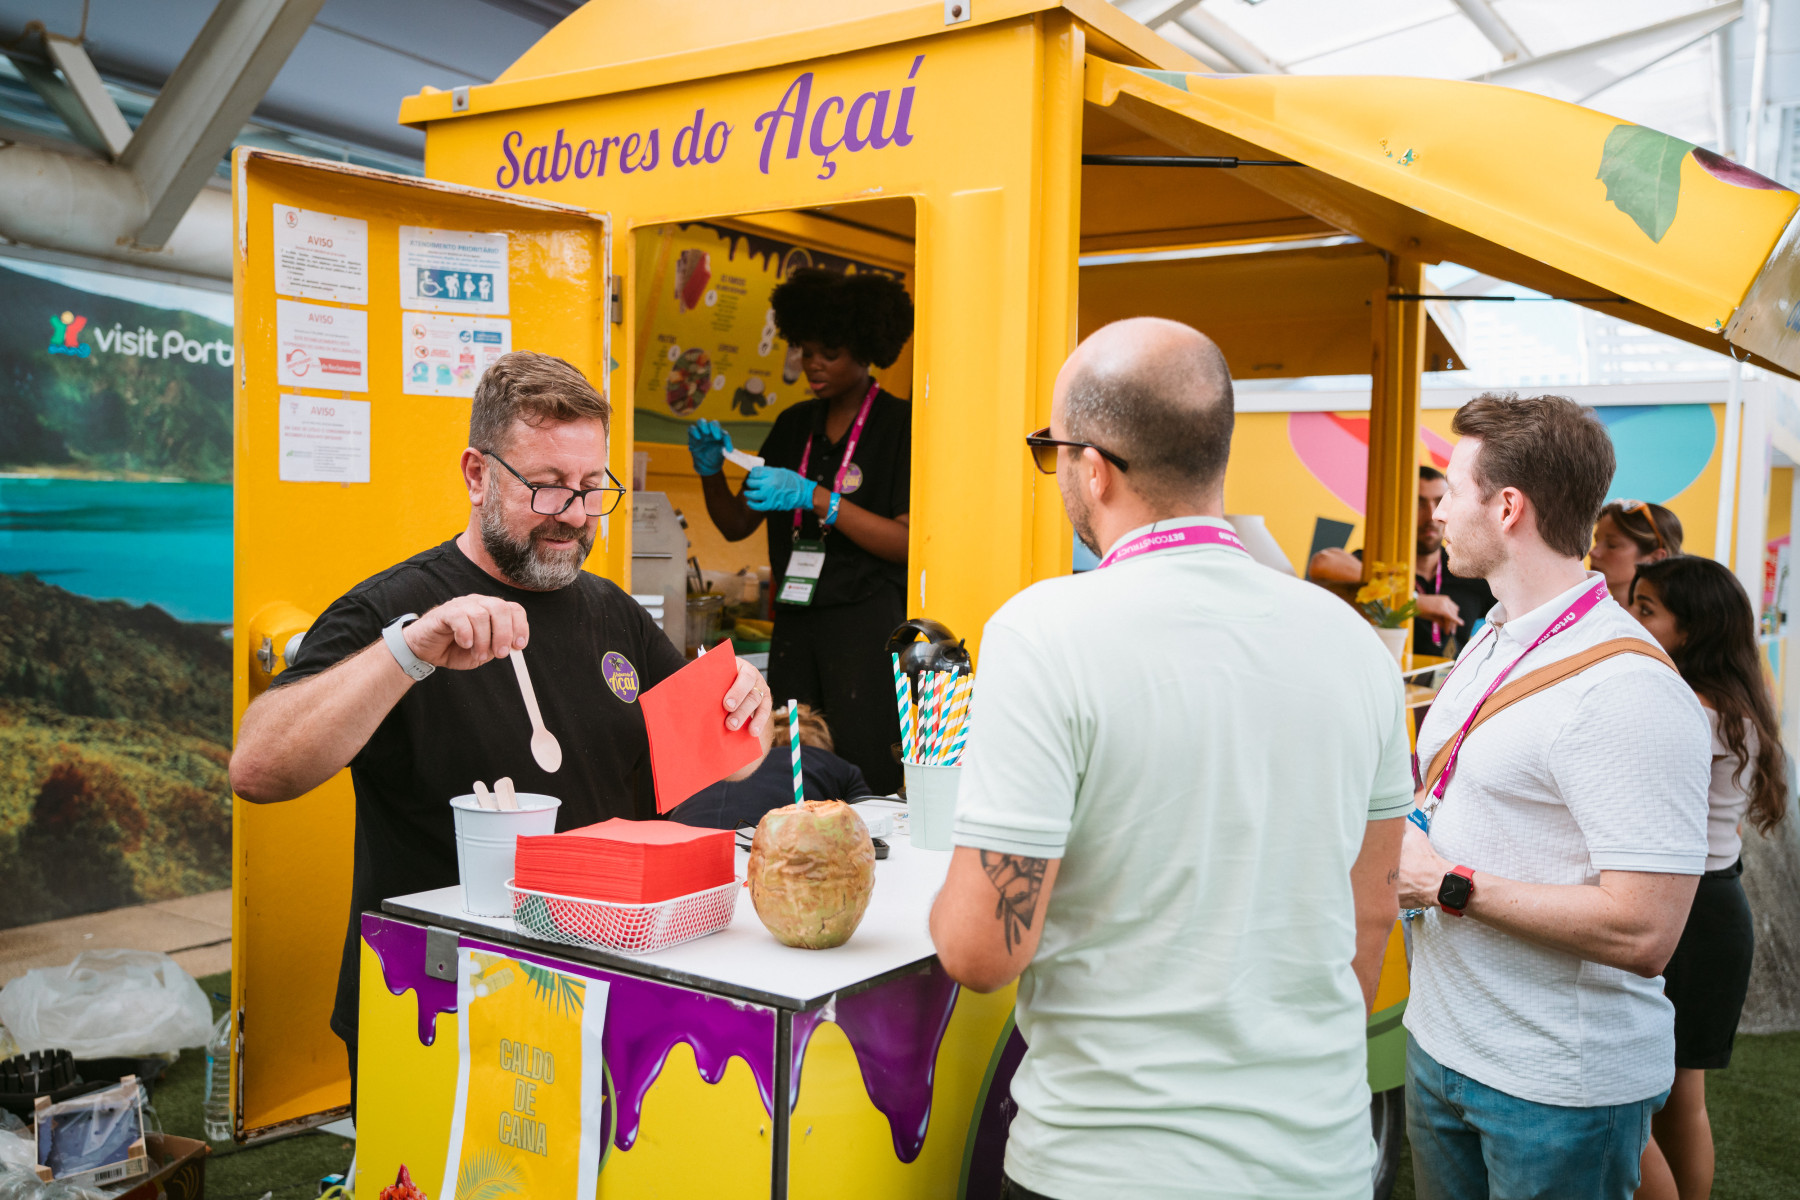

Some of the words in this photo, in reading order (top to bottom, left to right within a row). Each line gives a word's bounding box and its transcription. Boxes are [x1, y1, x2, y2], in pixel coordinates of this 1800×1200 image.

[496, 128, 660, 190] Sabores
[672, 108, 735, 168] do
[754, 54, 926, 181] Açaí
[307, 235, 334, 248] AVISO
[308, 312, 334, 325] AVISO
[310, 406, 336, 417] AVISO
[1116, 532, 1186, 558] BETCONSTRUCT
[500, 1038, 555, 1085] CALDO
[513, 1078, 537, 1117] DE
[498, 1110, 548, 1158] CANA
